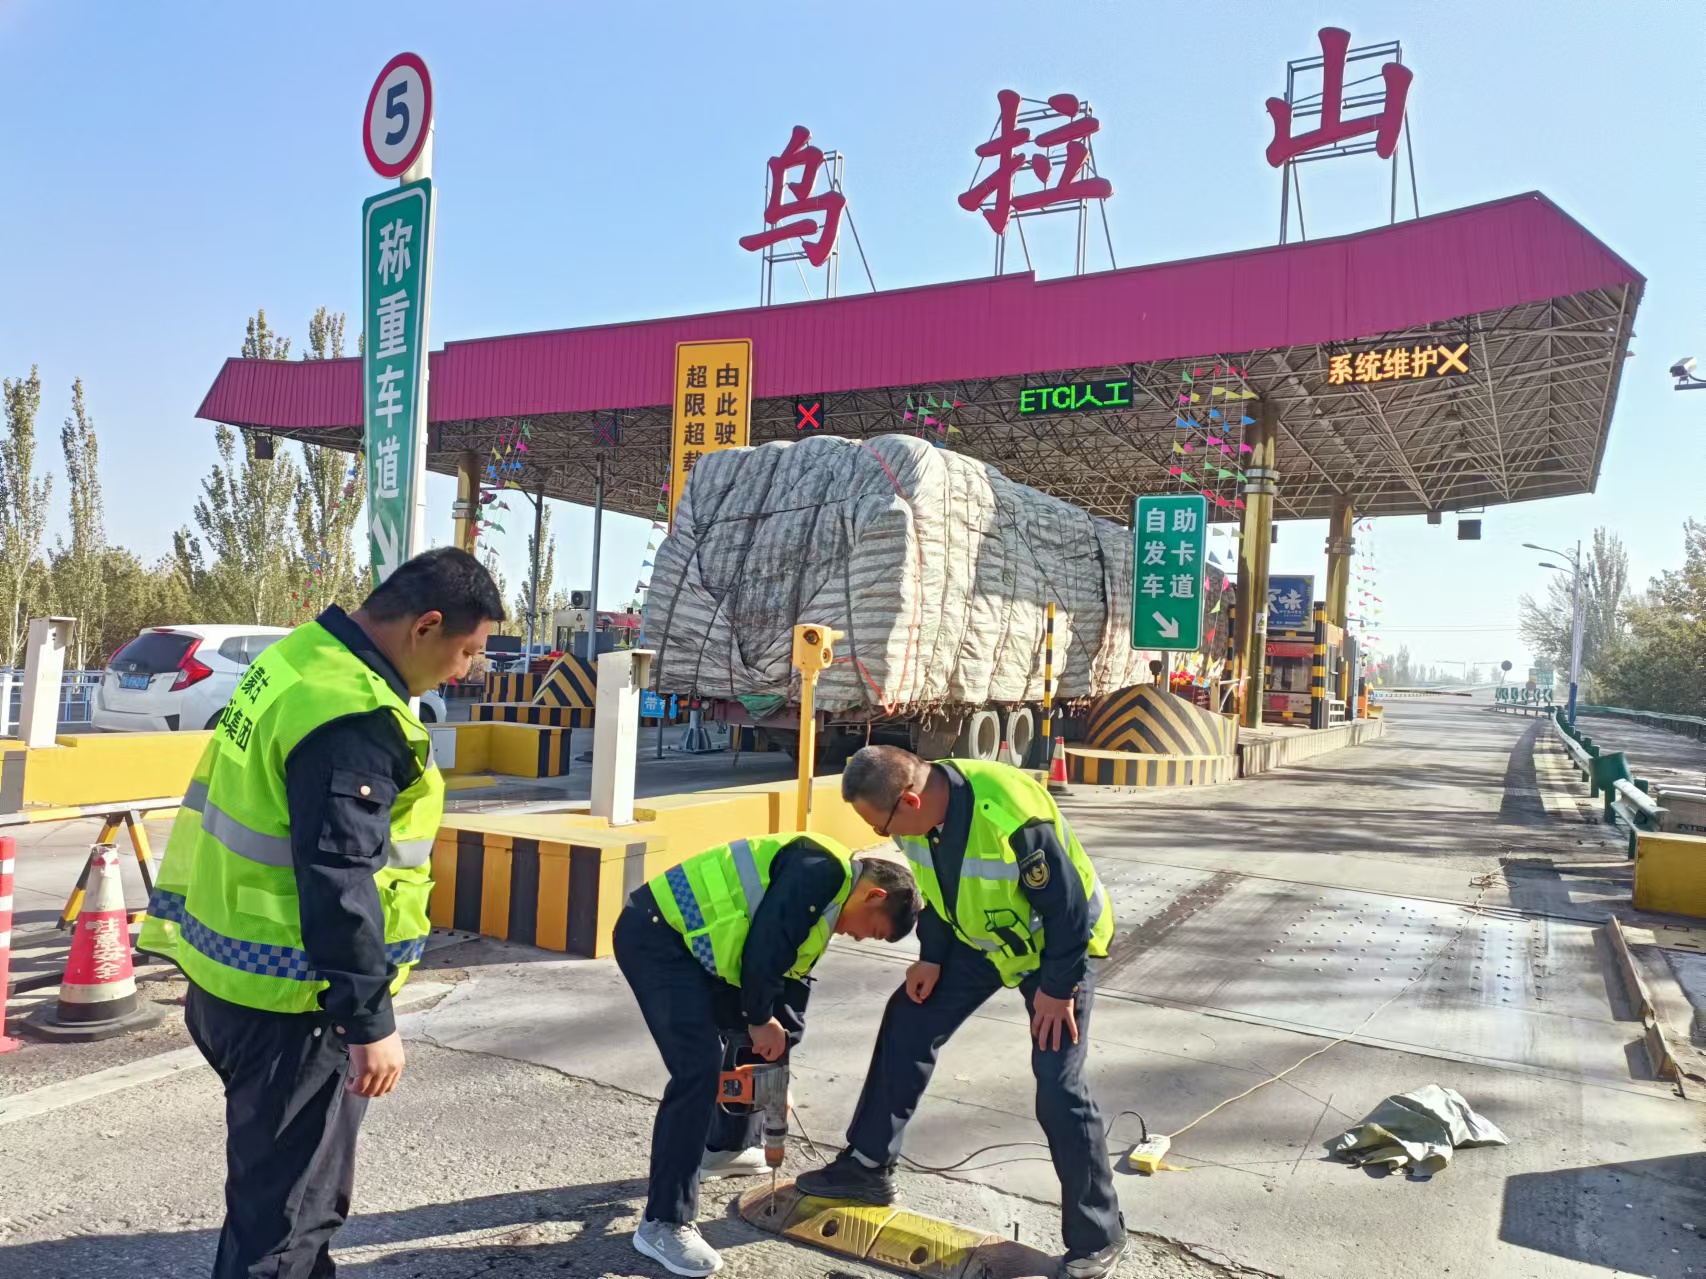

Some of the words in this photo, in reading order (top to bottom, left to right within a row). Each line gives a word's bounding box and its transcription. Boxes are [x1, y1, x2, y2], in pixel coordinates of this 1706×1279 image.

[385, 80, 410, 146] 5
[739, 26, 1413, 267] 乌拉山
[375, 218, 413, 499] 称重车道
[1145, 507, 1198, 533] 自助
[1142, 540, 1196, 566] 发卡
[1140, 573, 1195, 599] 车道
